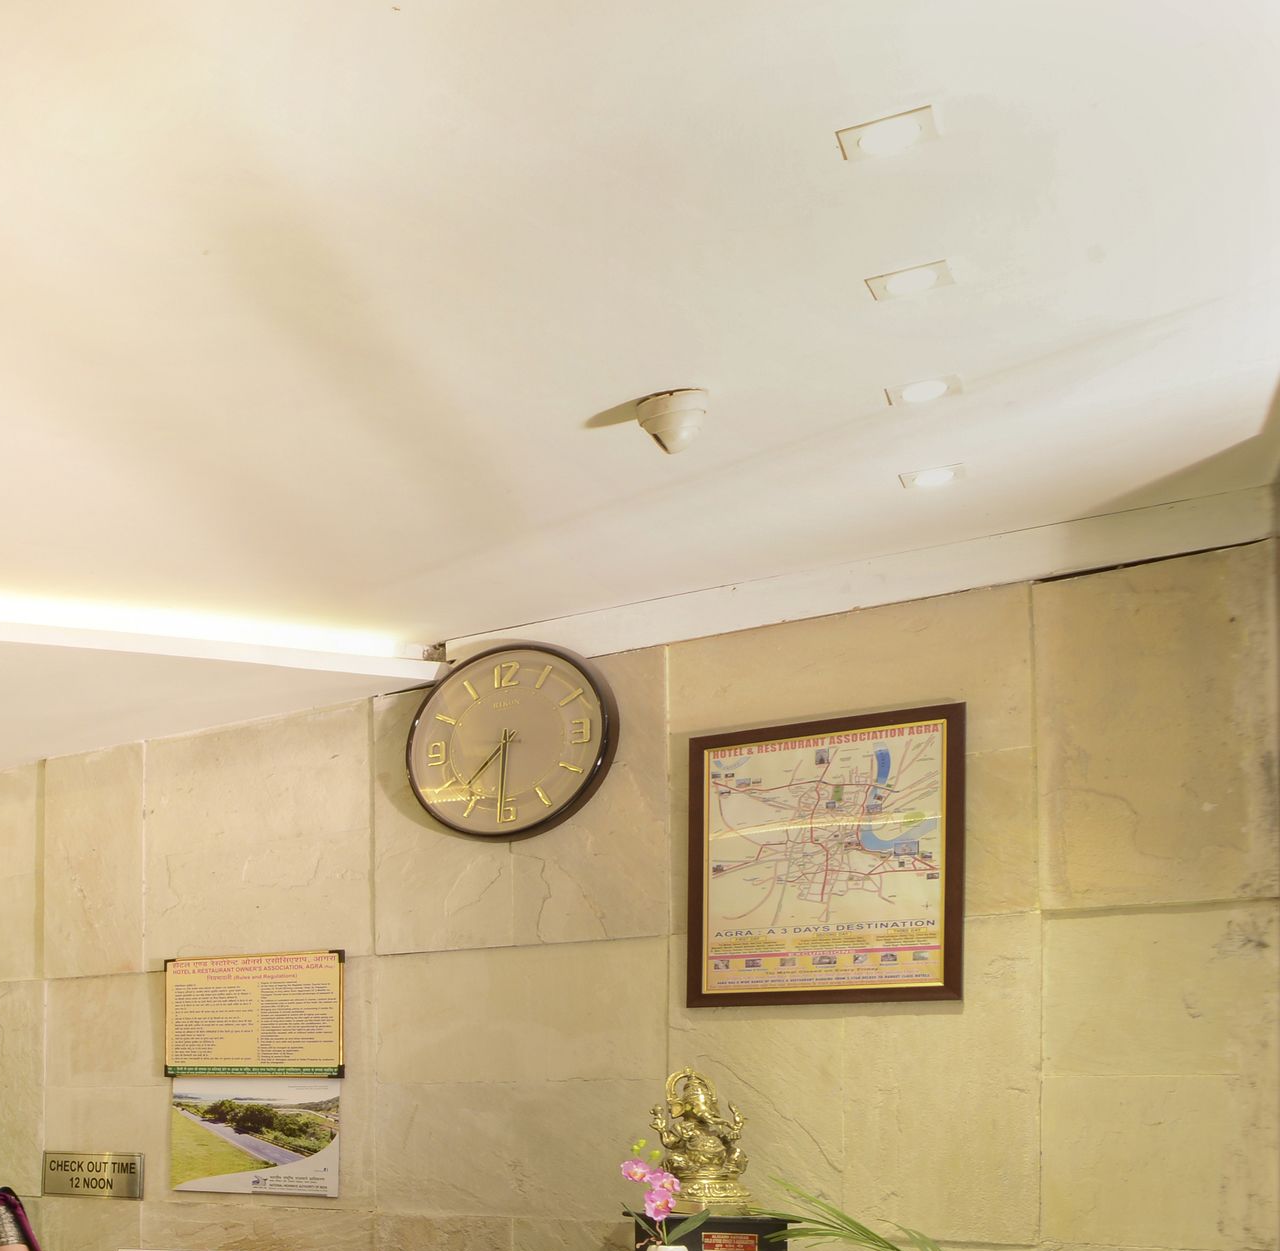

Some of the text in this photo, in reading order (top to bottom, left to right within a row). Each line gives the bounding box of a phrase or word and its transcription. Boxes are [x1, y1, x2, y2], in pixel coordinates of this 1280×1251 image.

[494, 661, 520, 689] 12
[713, 723, 940, 760] HOTEL & RESTAURANT ASSOCIATION AGRA
[714, 930, 753, 938] AGRA
[781, 927, 787, 935] 3
[793, 925, 830, 934] DAYS
[836, 919, 936, 931] DESTINATION
[49, 1159, 136, 1175] CHECK OUT TIME
[69, 1177, 114, 1190] 12 NOON
